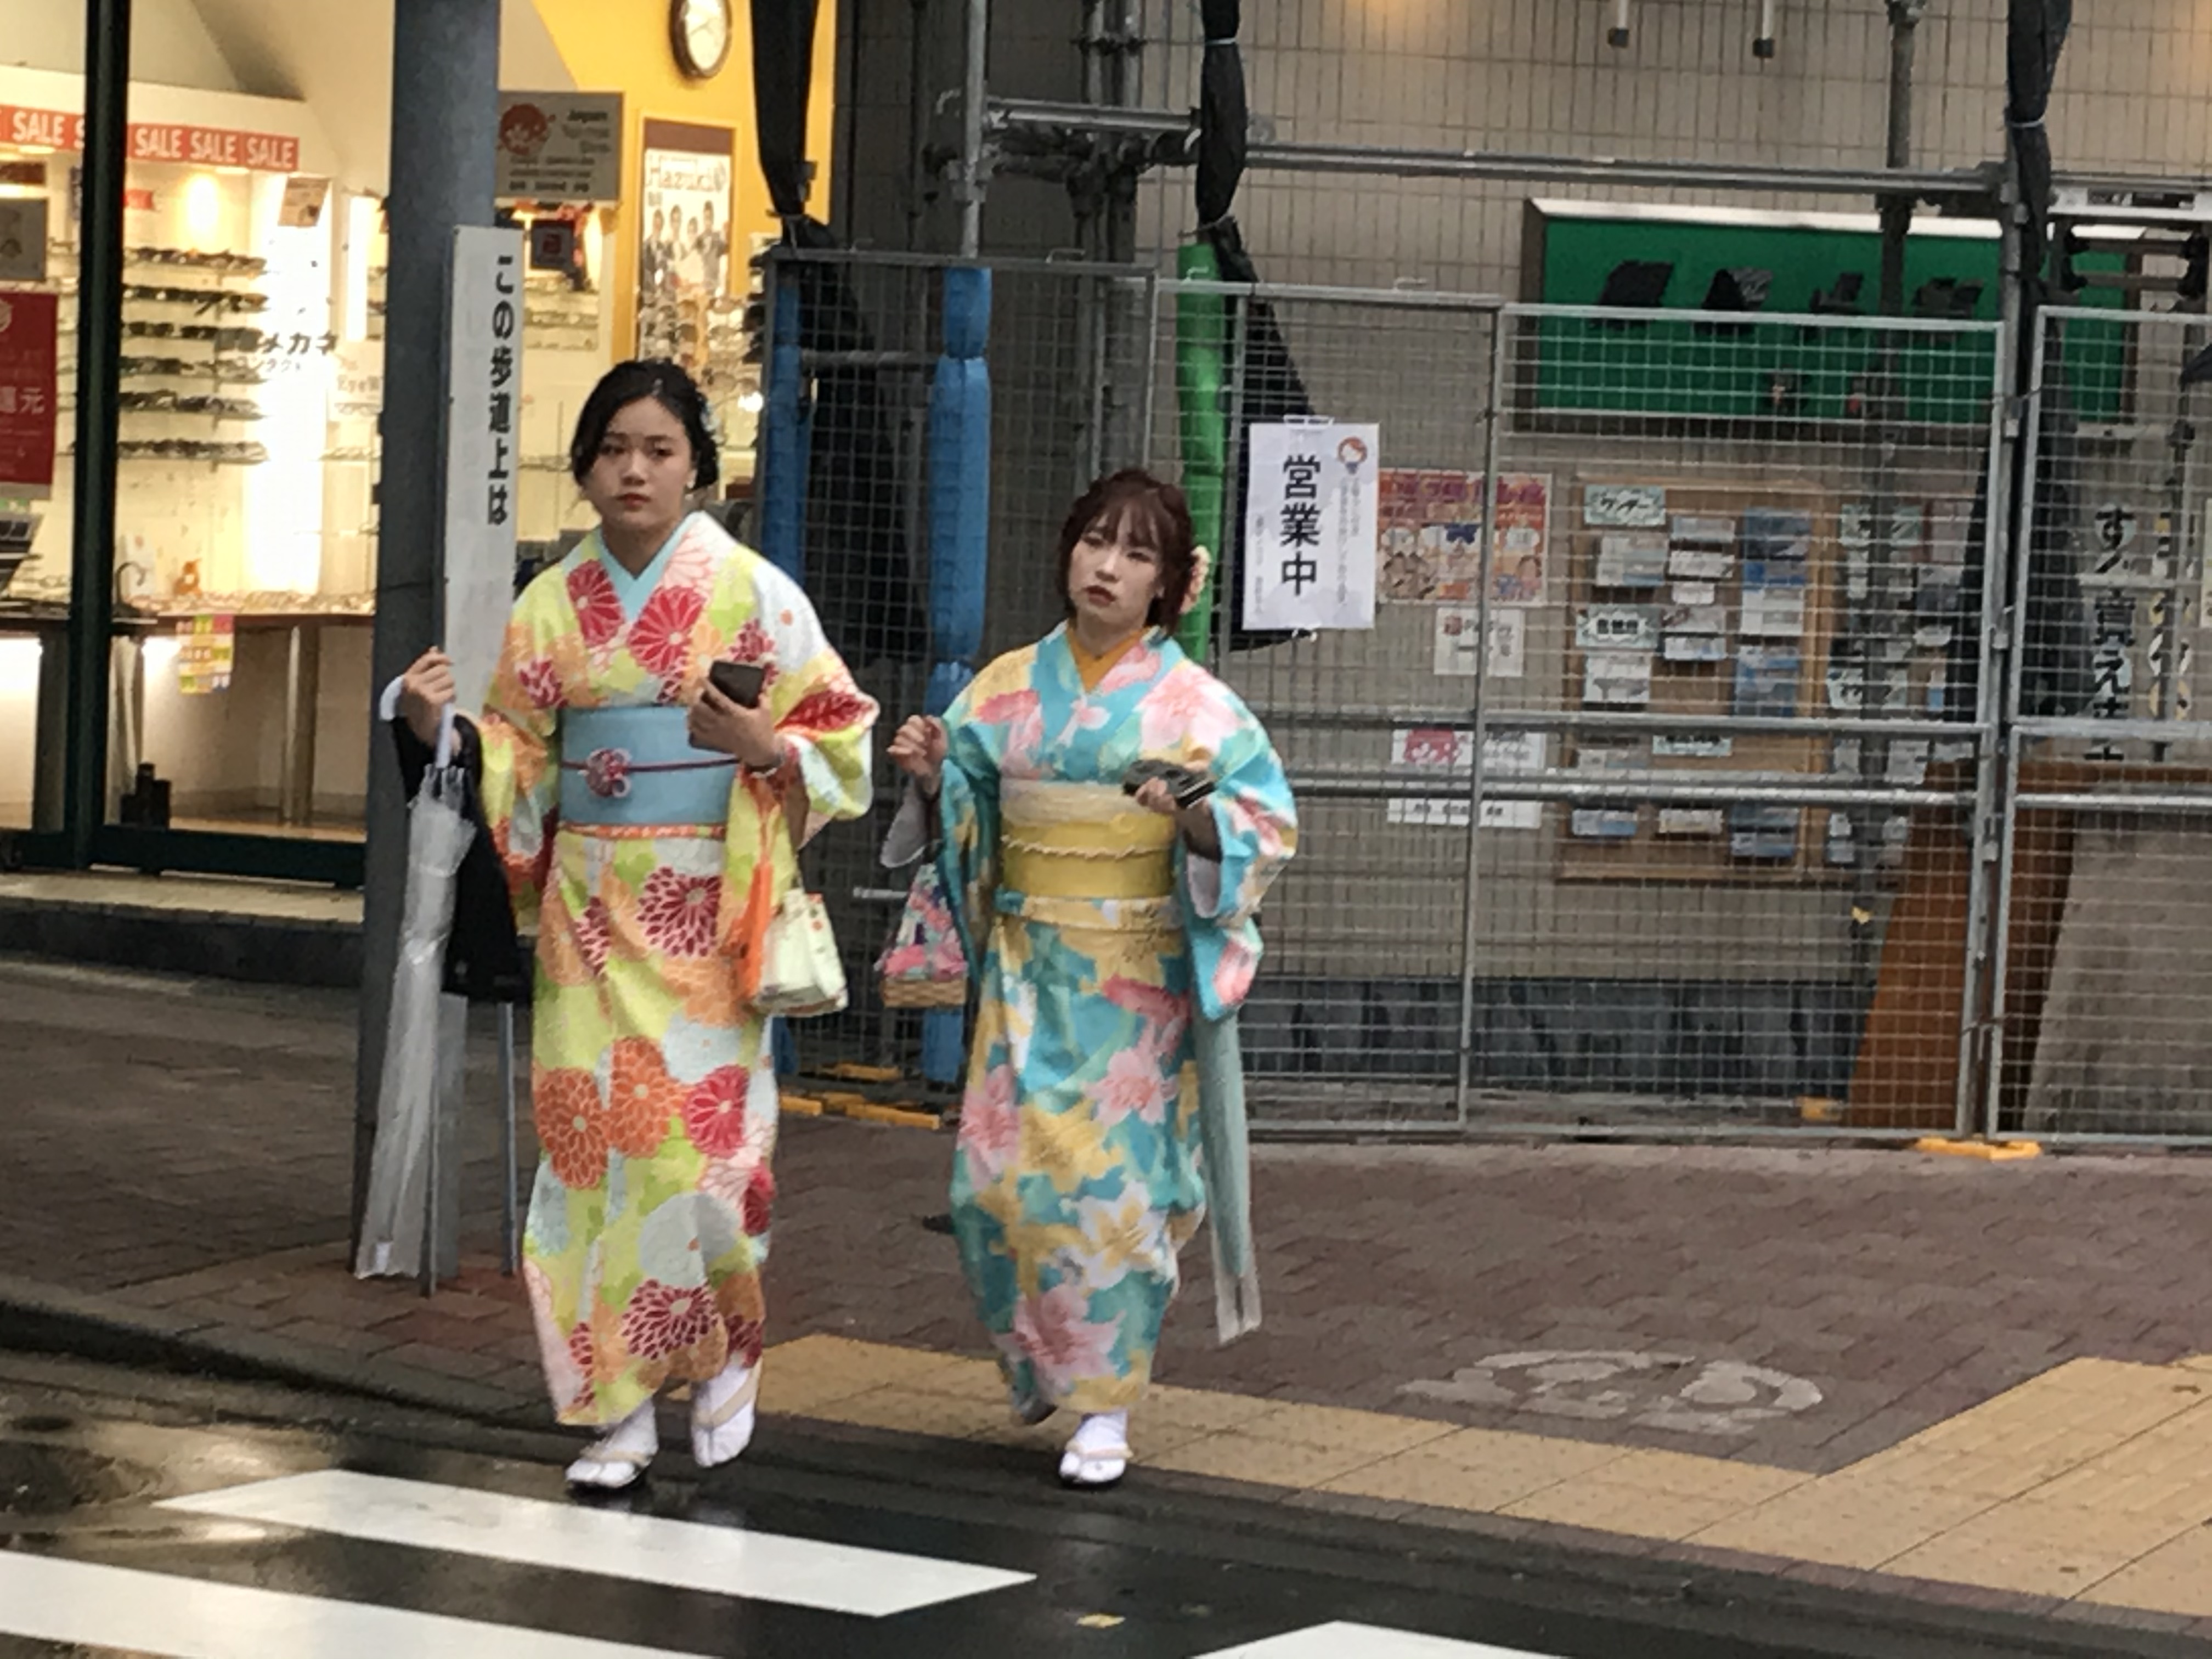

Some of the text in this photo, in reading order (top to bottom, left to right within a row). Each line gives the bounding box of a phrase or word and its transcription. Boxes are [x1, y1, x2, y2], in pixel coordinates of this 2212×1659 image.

[12, 111, 65, 145] SALE
[135, 127, 182, 157] SALE
[190, 131, 237, 162] SALE
[246, 137, 294, 168] SALE
[488, 255, 515, 526] この歩道上は
[1280, 454, 1322, 597] 営業中
